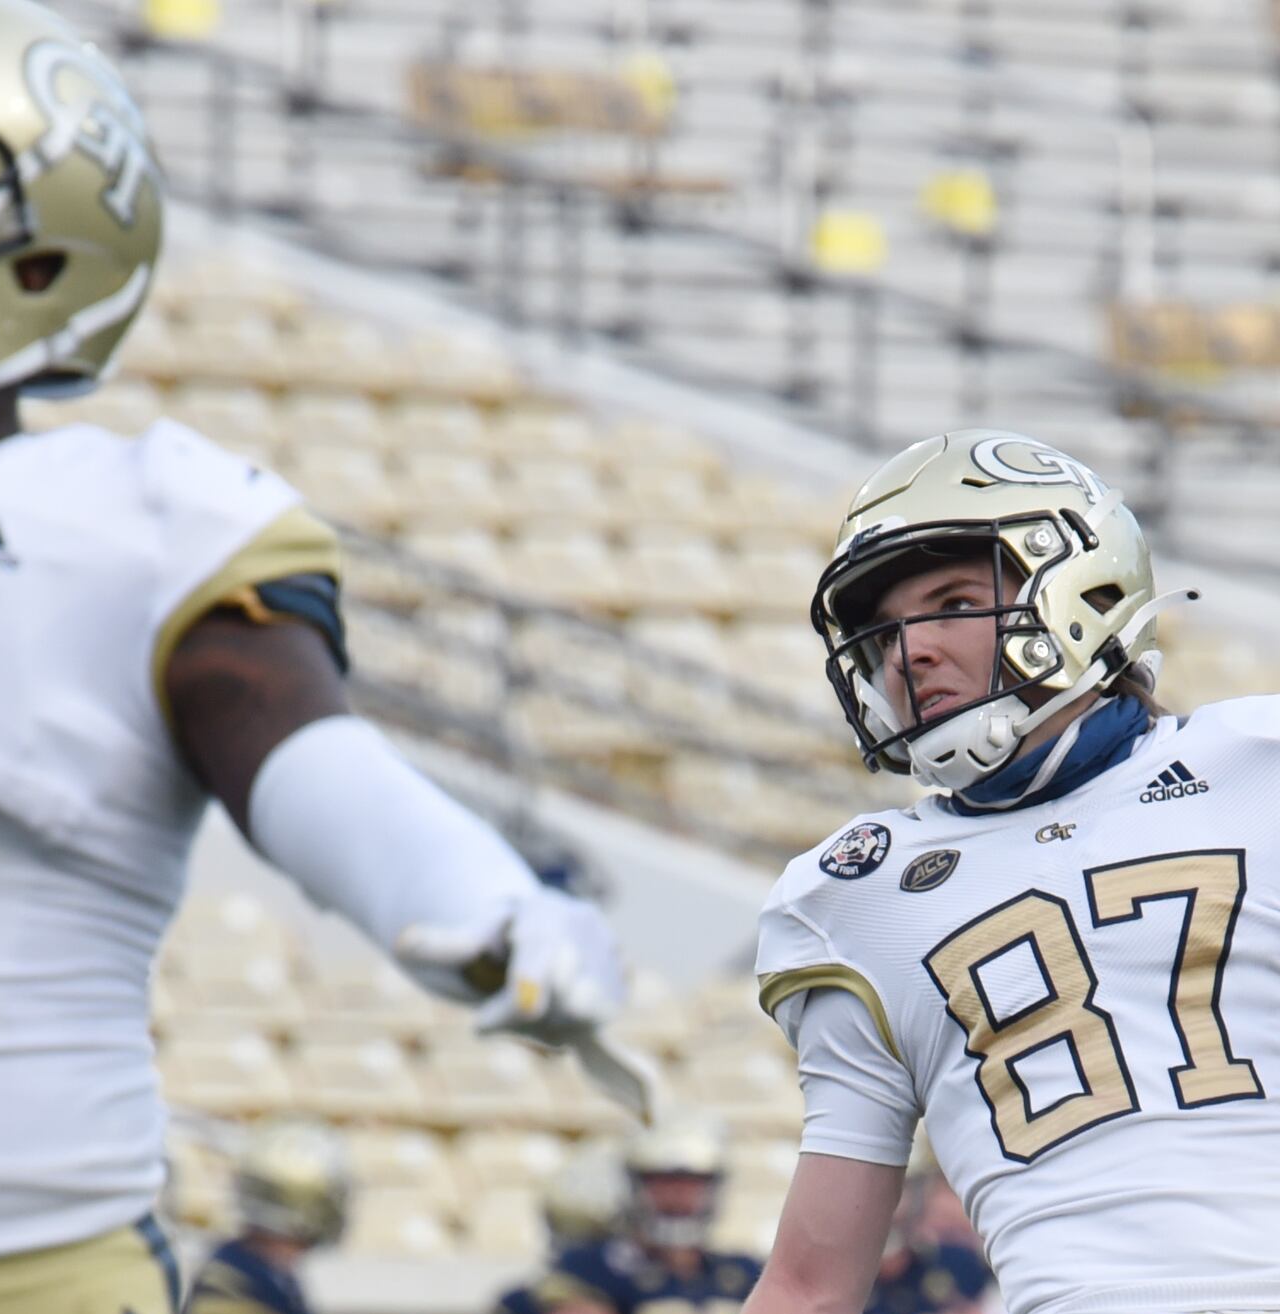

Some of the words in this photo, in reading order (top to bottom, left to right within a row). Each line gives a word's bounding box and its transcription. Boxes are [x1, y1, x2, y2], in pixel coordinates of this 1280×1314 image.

[1139, 780, 1210, 804] adidas
[1035, 822, 1077, 844] GT
[921, 847, 1266, 1164] 87
